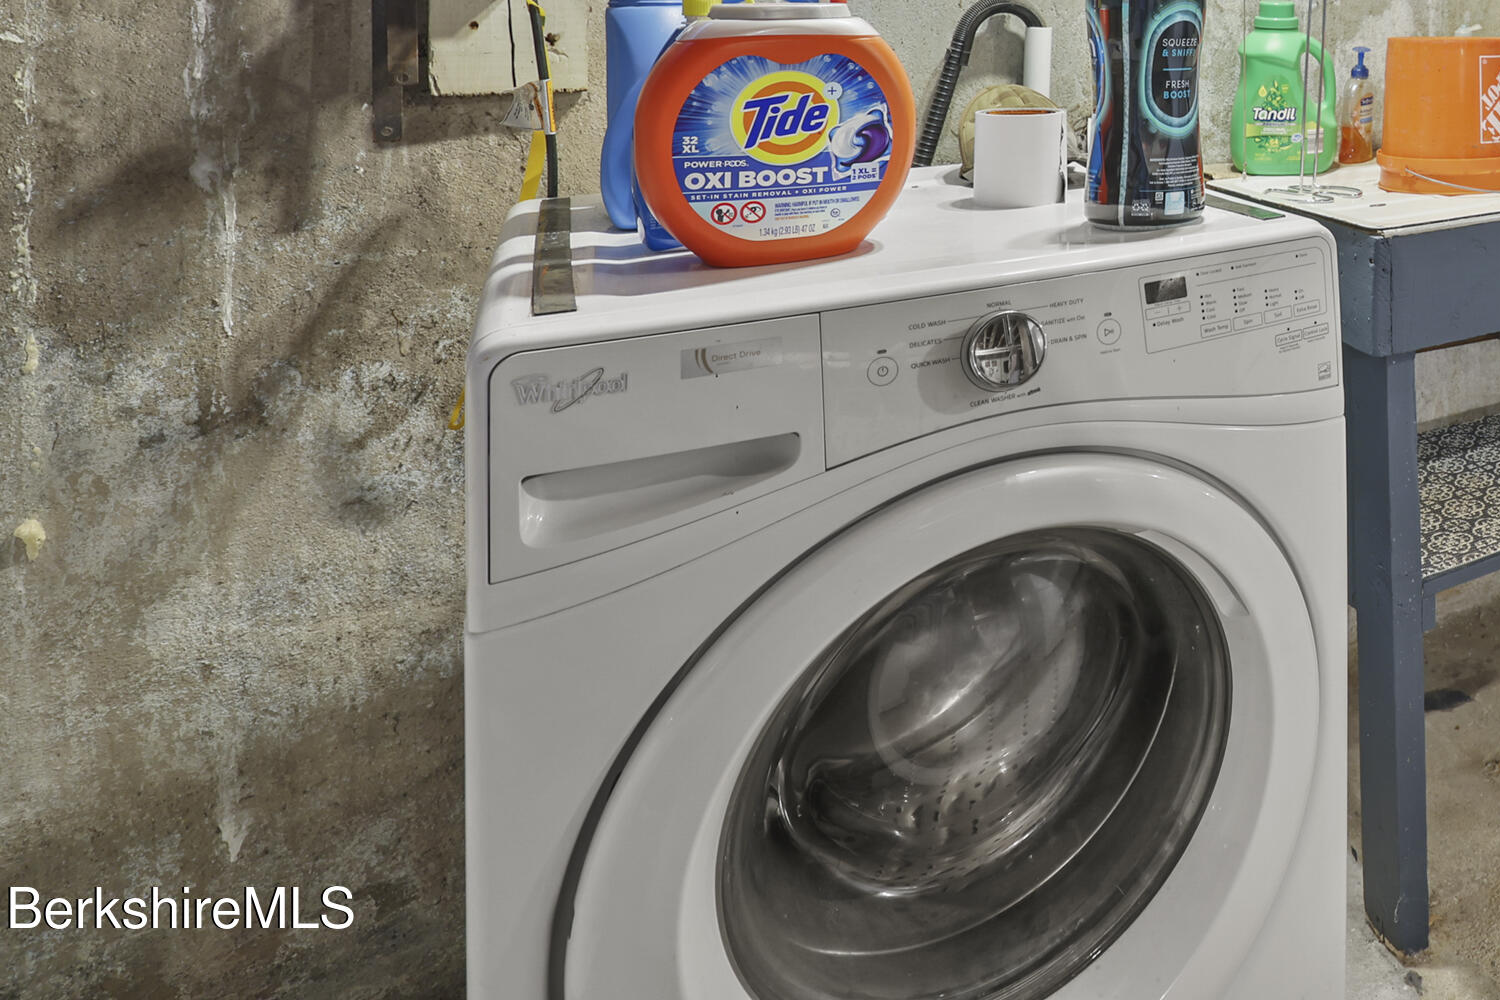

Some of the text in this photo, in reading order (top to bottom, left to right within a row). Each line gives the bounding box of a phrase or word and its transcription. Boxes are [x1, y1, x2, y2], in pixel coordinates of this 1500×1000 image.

[1162, 38, 1197, 47] SQUEEZE
[1162, 49, 1169, 57] &
[1165, 80, 1190, 88] FRESH
[1163, 90, 1191, 99] BOOST
[1253, 107, 1296, 121] Tandil
[742, 93, 830, 150] Tide
[682, 136, 698, 144] 32
[682, 145, 699, 153] XL
[684, 167, 828, 190] OXI BOOST
[752, 190, 792, 198] REMOVAL
[760, 227, 770, 236] 1.34
[771, 227, 778, 237] kg
[801, 224, 808, 232] 47
[986, 300, 1012, 308] NORMAL
[1068, 298, 1084, 306] DUTY
[908, 323, 926, 331] COLD
[1157, 319, 1171, 328] Delay
[908, 338, 943, 349] DELICATES
[1050, 337, 1068, 345] DRAIN
[711, 350, 761, 362] Direct Drive
[911, 357, 951, 369] QUICK WASH
[511, 370, 628, 410] Whirlpool
[969, 399, 989, 408] CLEAN
[991, 393, 1016, 403] WASHER
